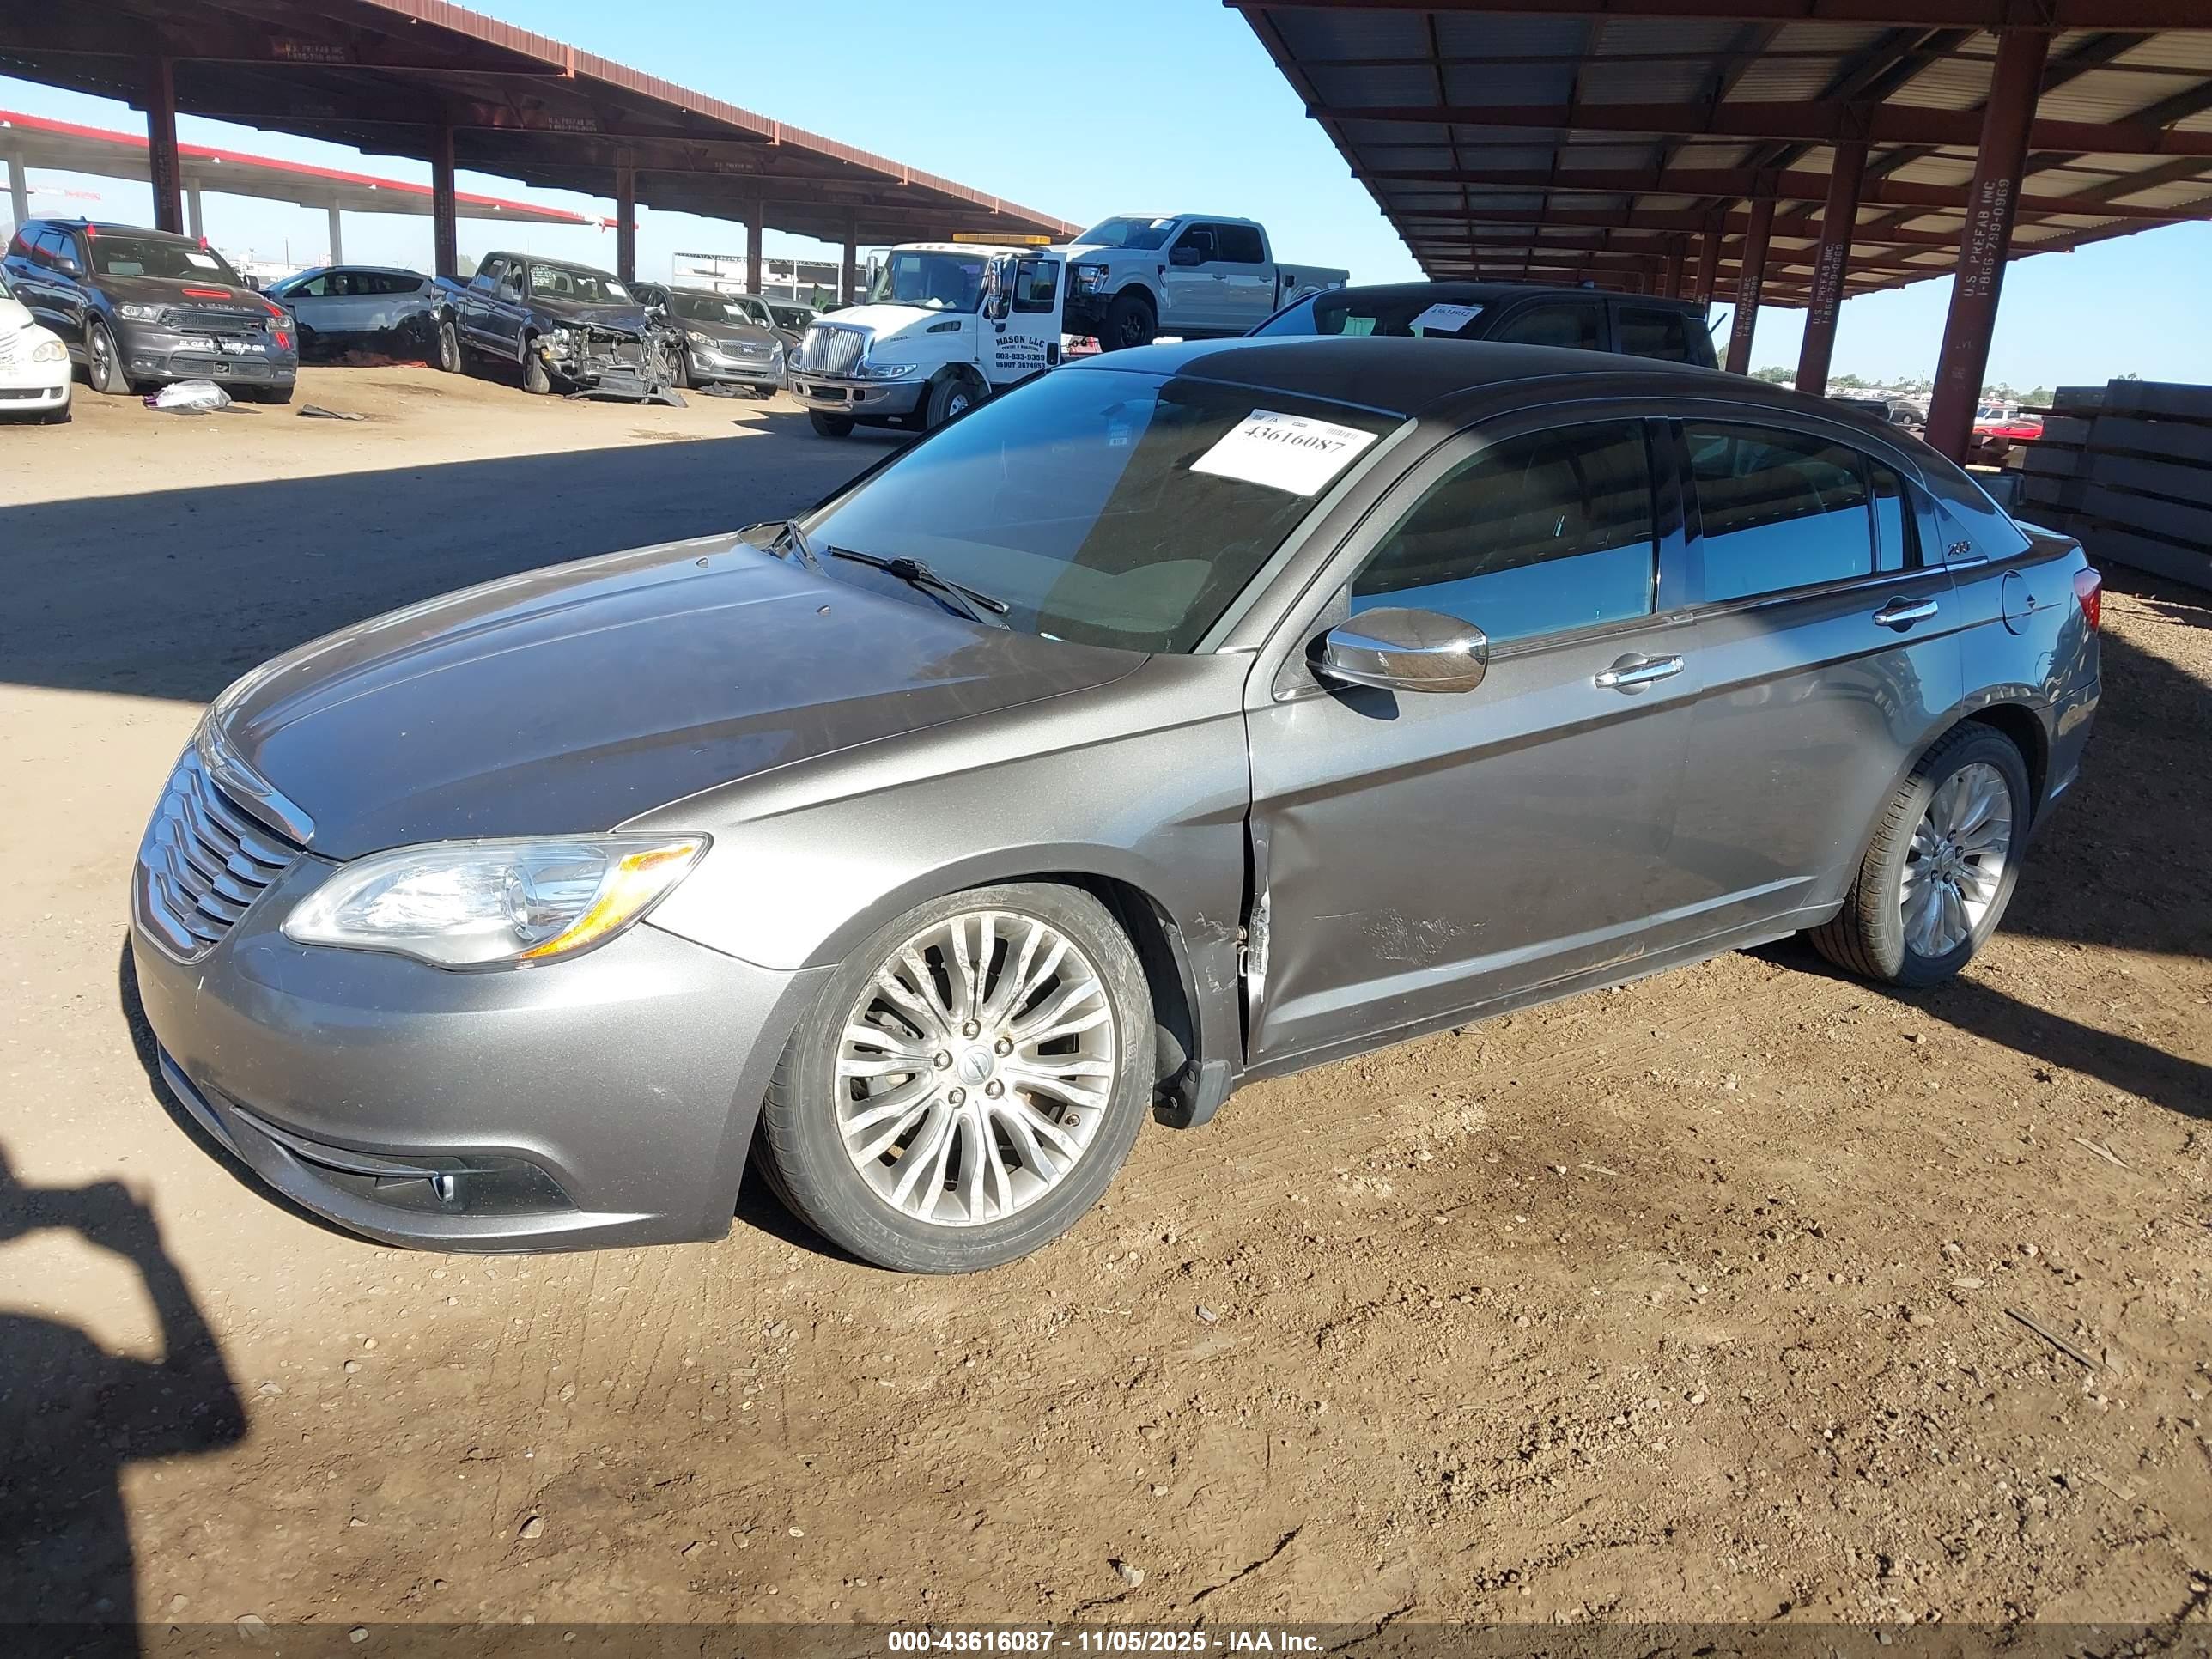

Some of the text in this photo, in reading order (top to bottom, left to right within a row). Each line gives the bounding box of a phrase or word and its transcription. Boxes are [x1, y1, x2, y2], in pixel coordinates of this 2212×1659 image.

[1970, 210, 1990, 263] PREFAB
[1981, 178, 1997, 204] INC.
[1977, 179, 2010, 296] 1-866-799-0969
[1816, 265, 1831, 302] PREFAB
[995, 335, 1045, 349] MASON LLC
[1244, 424, 1346, 453] 43616087
